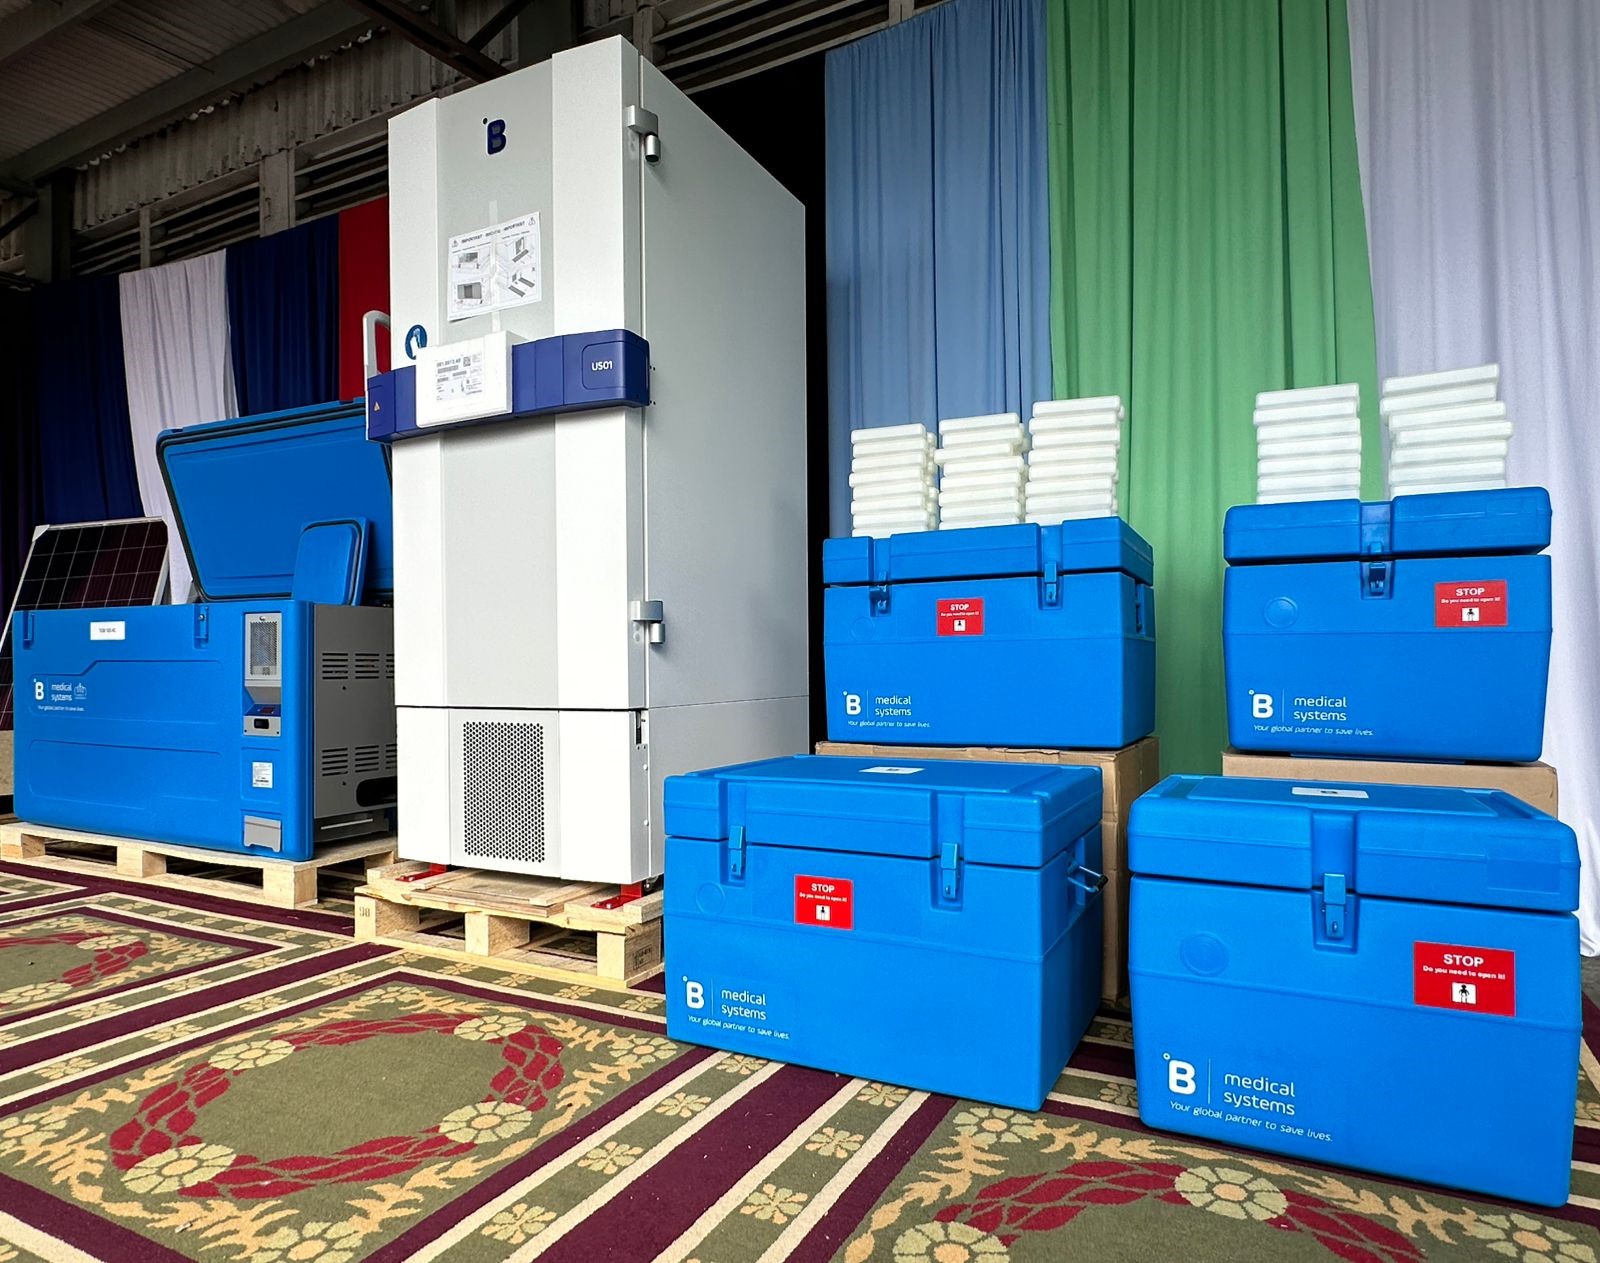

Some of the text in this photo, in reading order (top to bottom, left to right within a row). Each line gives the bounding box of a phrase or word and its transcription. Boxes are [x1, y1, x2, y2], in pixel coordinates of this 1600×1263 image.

[483, 117, 507, 155] B
[591, 360, 613, 371] US01
[1455, 587, 1486, 597] STOP
[950, 603, 970, 611] STOP
[33, 678, 45, 700] B
[842, 690, 861, 715] B
[875, 695, 912, 705] medical
[1248, 689, 1274, 719] B
[1294, 695, 1347, 708] medical
[874, 707, 912, 718] systems
[1293, 710, 1347, 722] systems
[1270, 725, 1293, 733] global
[1295, 726, 1323, 734] partner
[1354, 728, 1374, 736] lives.
[811, 883, 835, 893] STOP
[1443, 953, 1484, 967] STOP
[682, 975, 705, 1009] B
[721, 989, 766, 1006] medical
[721, 1004, 767, 1020] systems
[688, 1014, 702, 1023] Your
[702, 1017, 721, 1026] global
[722, 1021, 747, 1031] partner
[757, 1028, 772, 1036] save
[773, 1030, 790, 1039] lives.
[1162, 1052, 1197, 1095] B
[1224, 1073, 1296, 1098] medical
[1223, 1091, 1296, 1116] systems
[1170, 1100, 1333, 1142] Your global partner to save lives.
